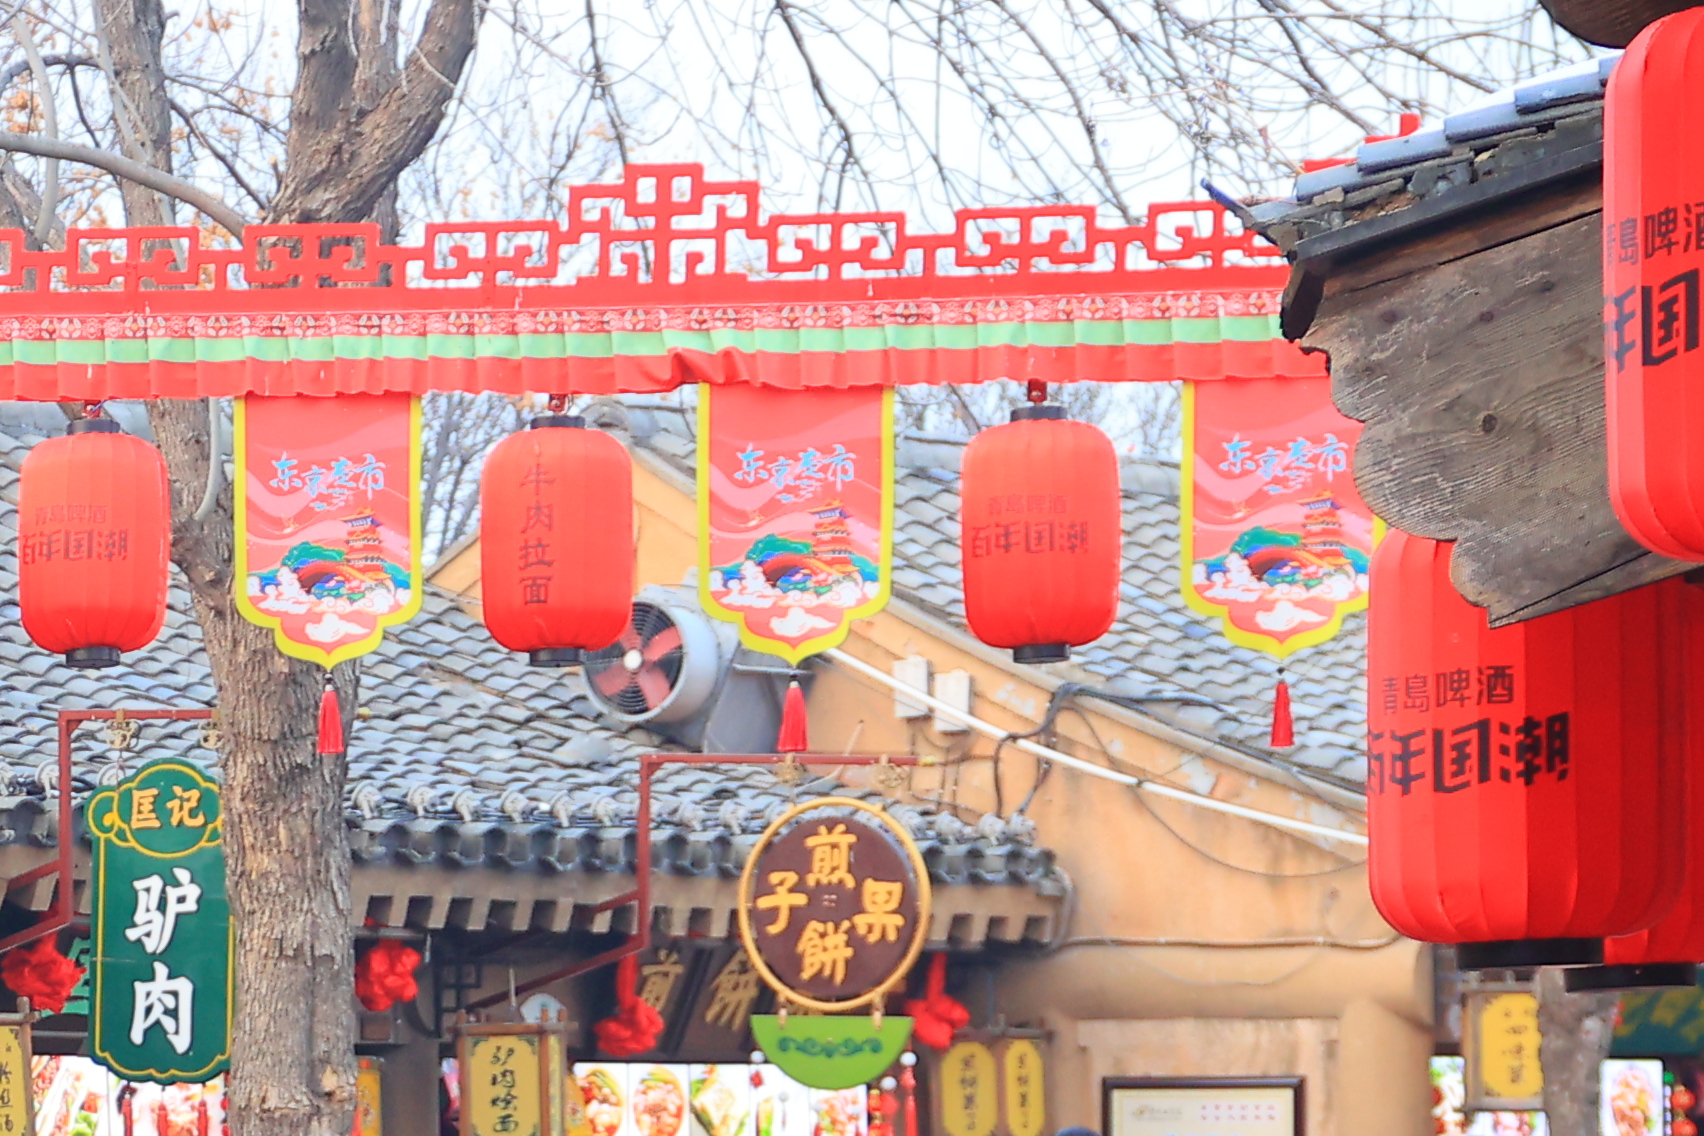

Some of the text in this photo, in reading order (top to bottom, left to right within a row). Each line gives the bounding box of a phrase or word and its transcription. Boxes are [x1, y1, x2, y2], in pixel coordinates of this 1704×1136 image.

[519, 462, 556, 606] 牛肉拉面
[971, 521, 1088, 558] 百年国潮
[128, 786, 206, 831] 匡记
[126, 866, 201, 1056] 驴肉
